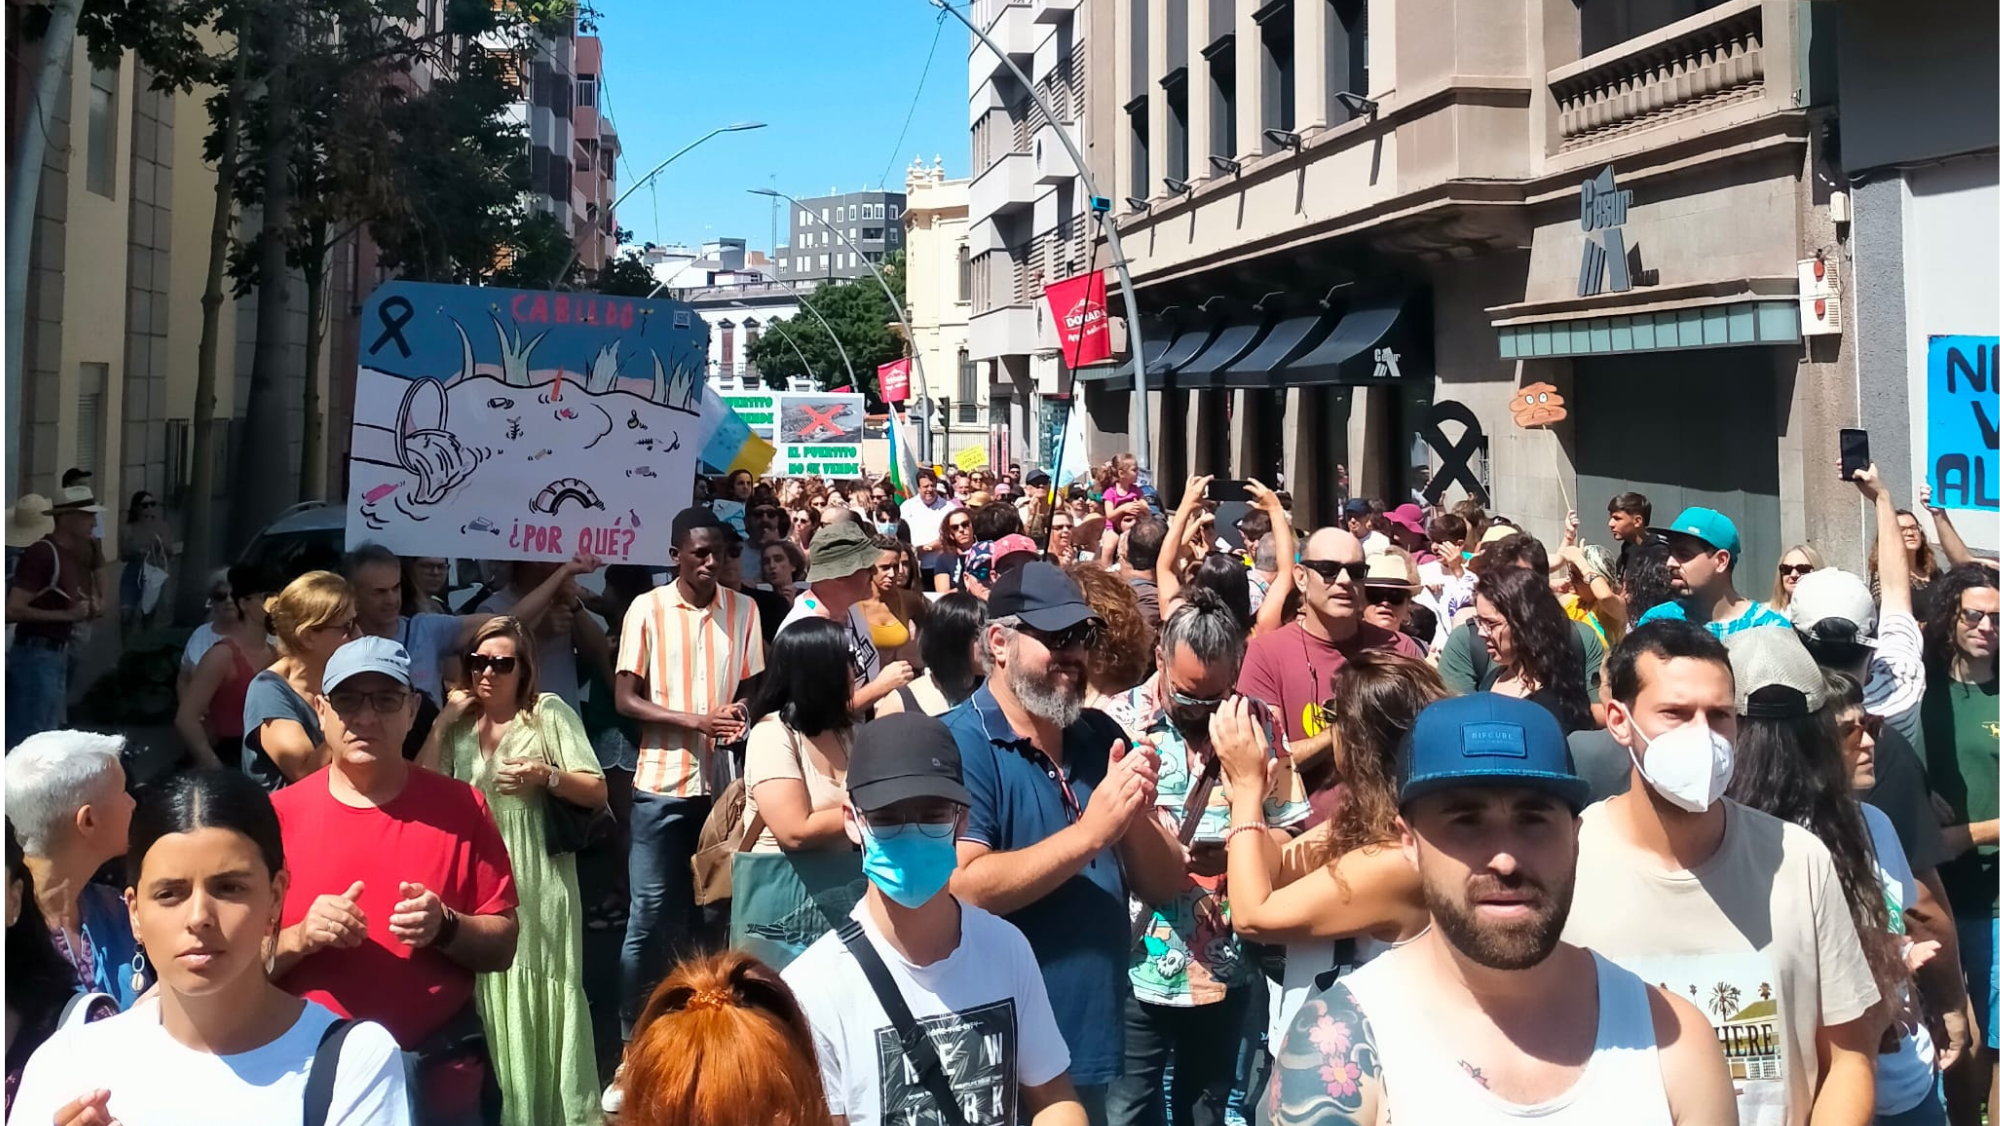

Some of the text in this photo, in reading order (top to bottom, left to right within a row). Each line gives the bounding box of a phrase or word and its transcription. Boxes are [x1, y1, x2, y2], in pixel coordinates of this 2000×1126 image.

[511, 294, 634, 329] CABILDO
[788, 446, 857, 458] EL PUERTITO
[788, 463, 804, 474] NO
[822, 463, 859, 474] VENDE
[509, 516, 636, 561] ¿POR QUÉ?
